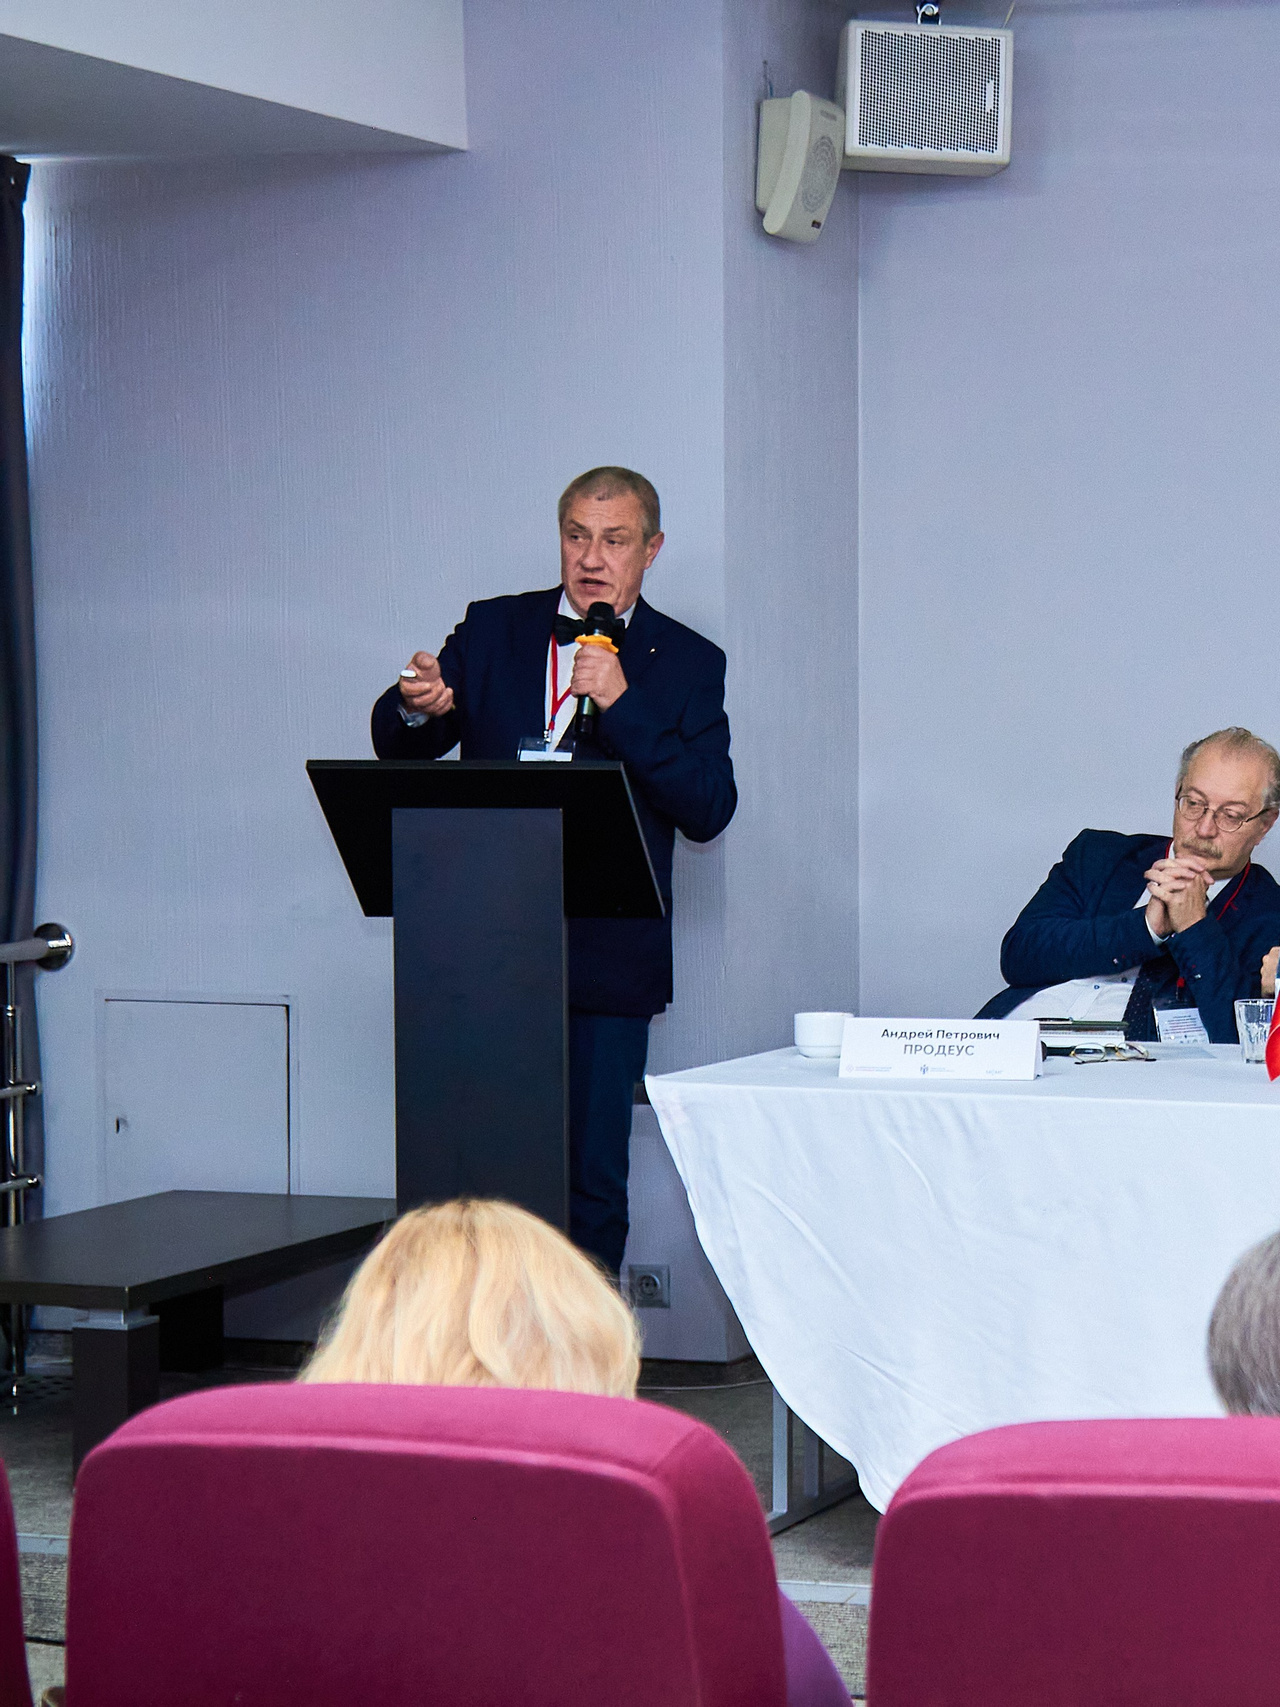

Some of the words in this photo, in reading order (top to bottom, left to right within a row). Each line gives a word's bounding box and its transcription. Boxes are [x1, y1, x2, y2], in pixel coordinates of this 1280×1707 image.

[881, 1028, 933, 1041] Андрей
[936, 1029, 1000, 1042] Петрович
[903, 1044, 975, 1057] ПРОДЕУС
